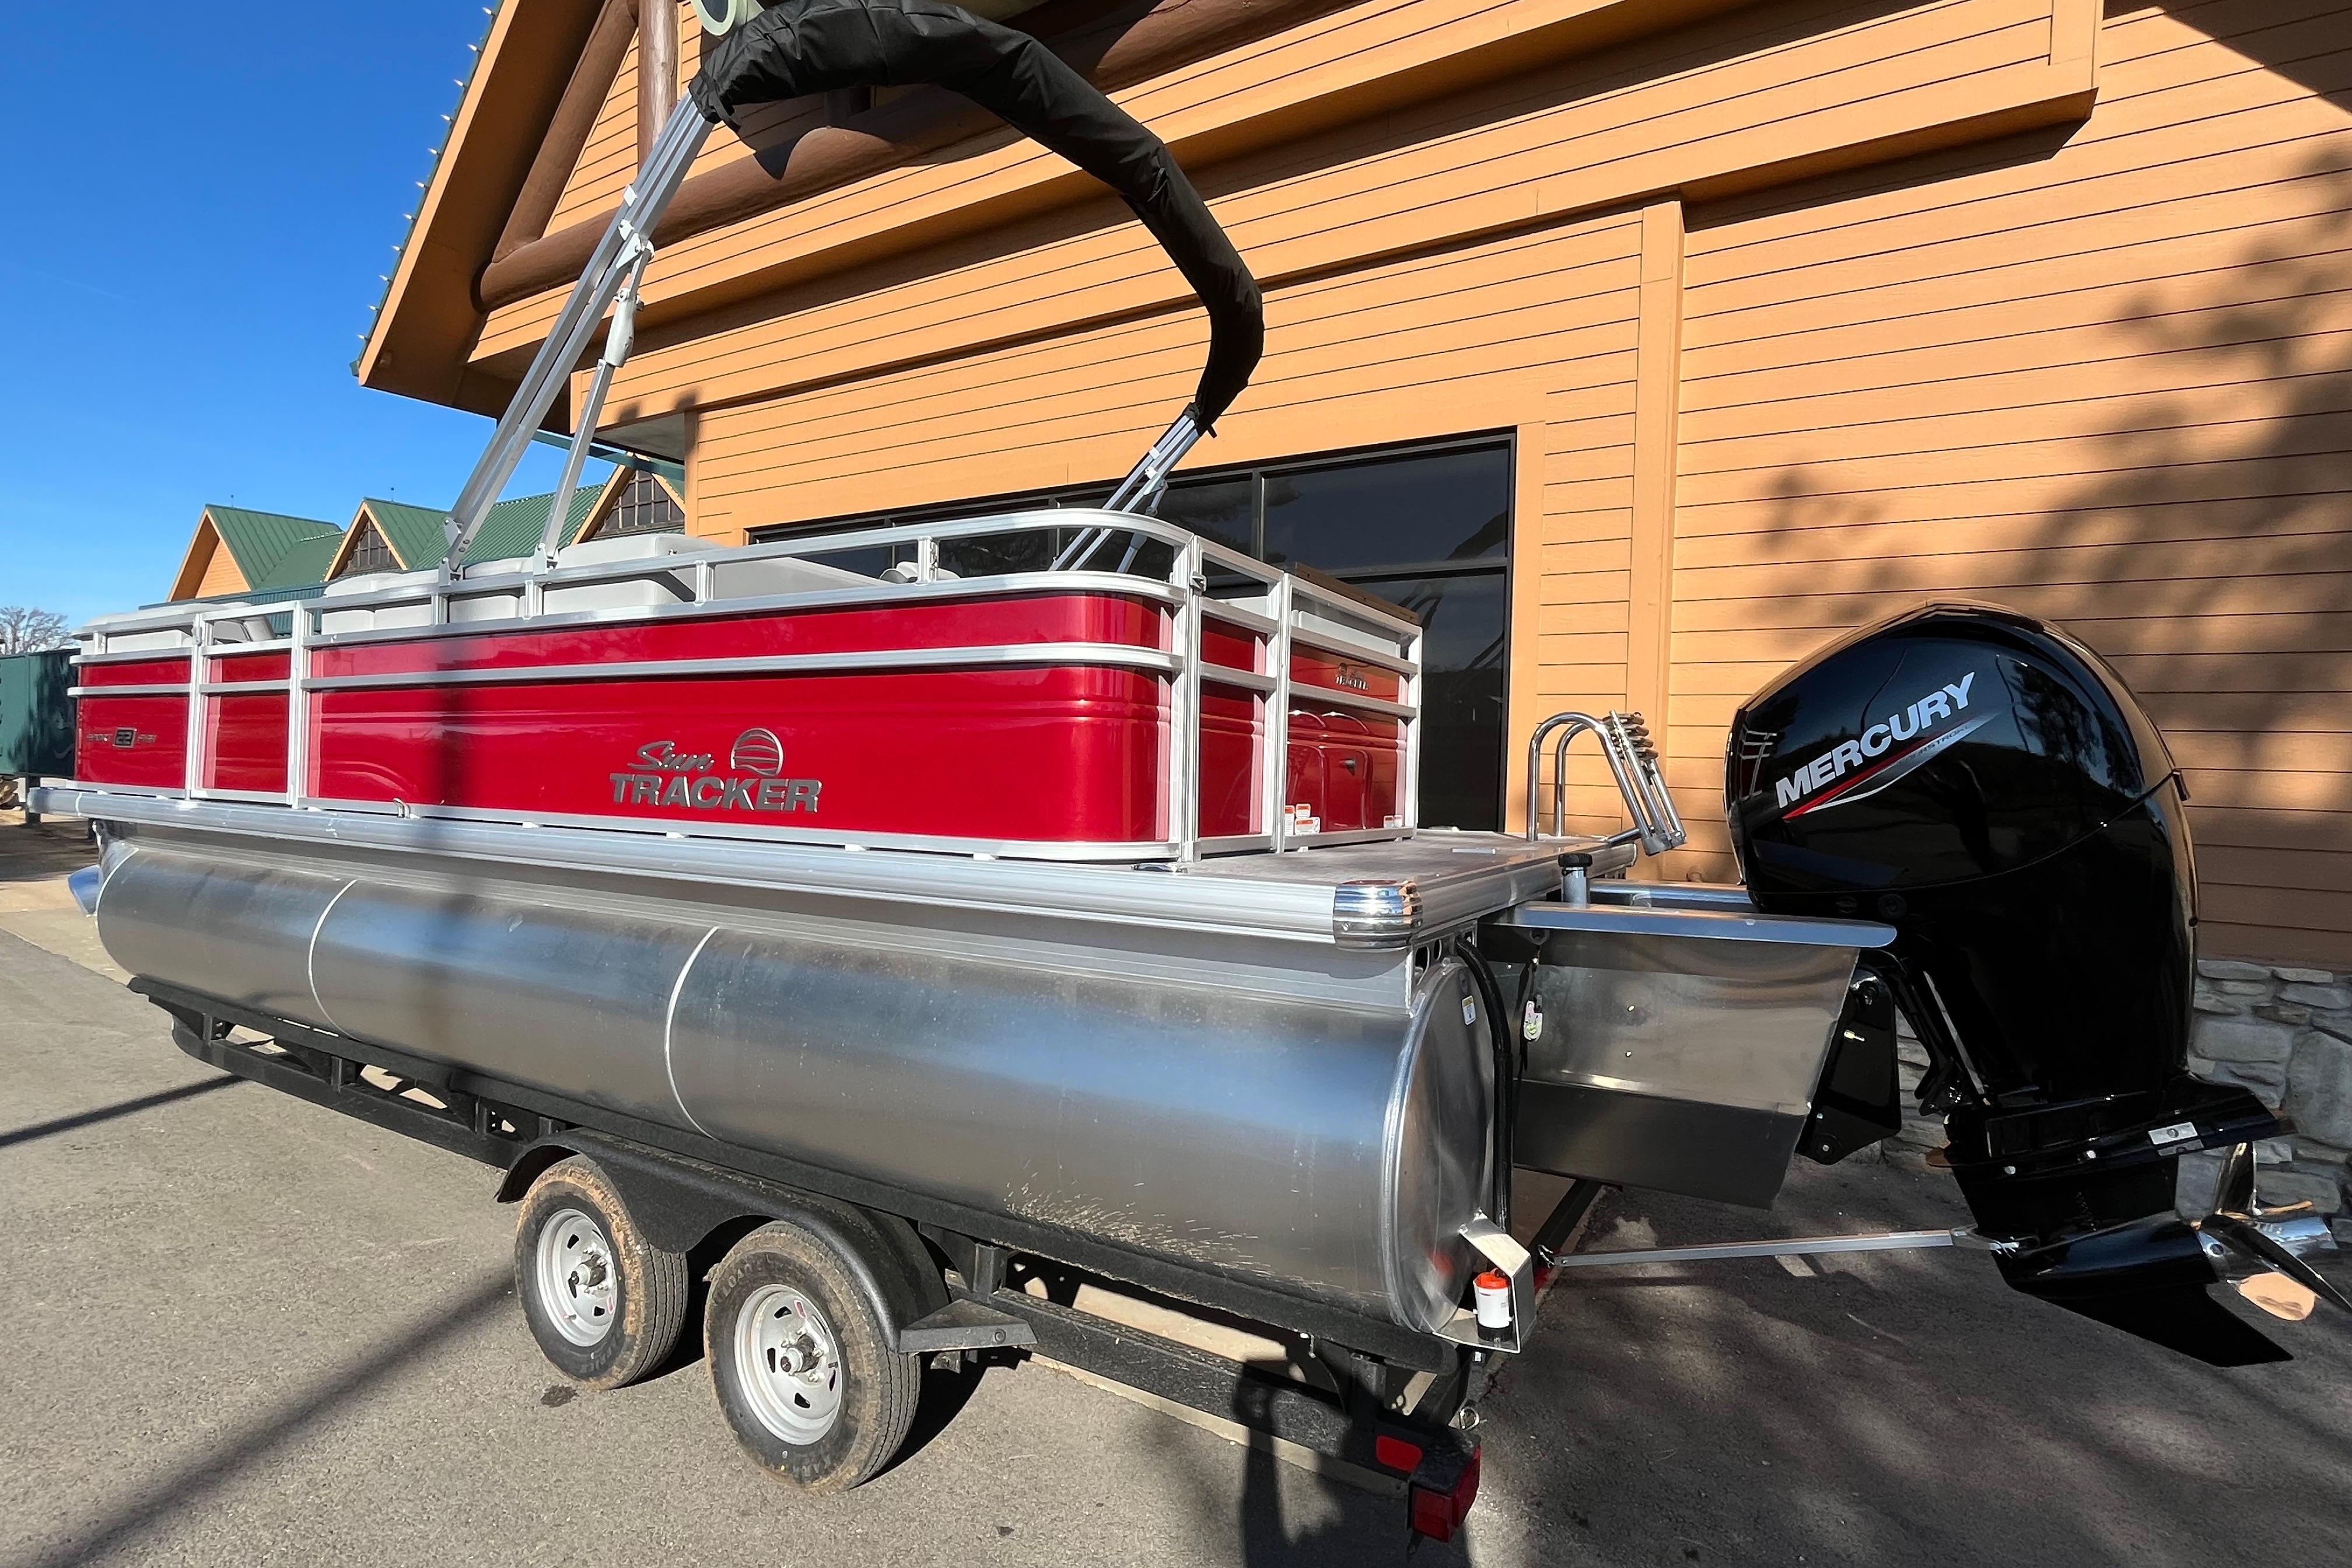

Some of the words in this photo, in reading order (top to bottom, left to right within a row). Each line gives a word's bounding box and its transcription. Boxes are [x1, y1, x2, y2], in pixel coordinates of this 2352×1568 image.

[116, 730, 132, 745] 22
[1775, 671, 1975, 809] MERCURY
[626, 740, 715, 772] Sun
[610, 772, 822, 813] TRACKER
